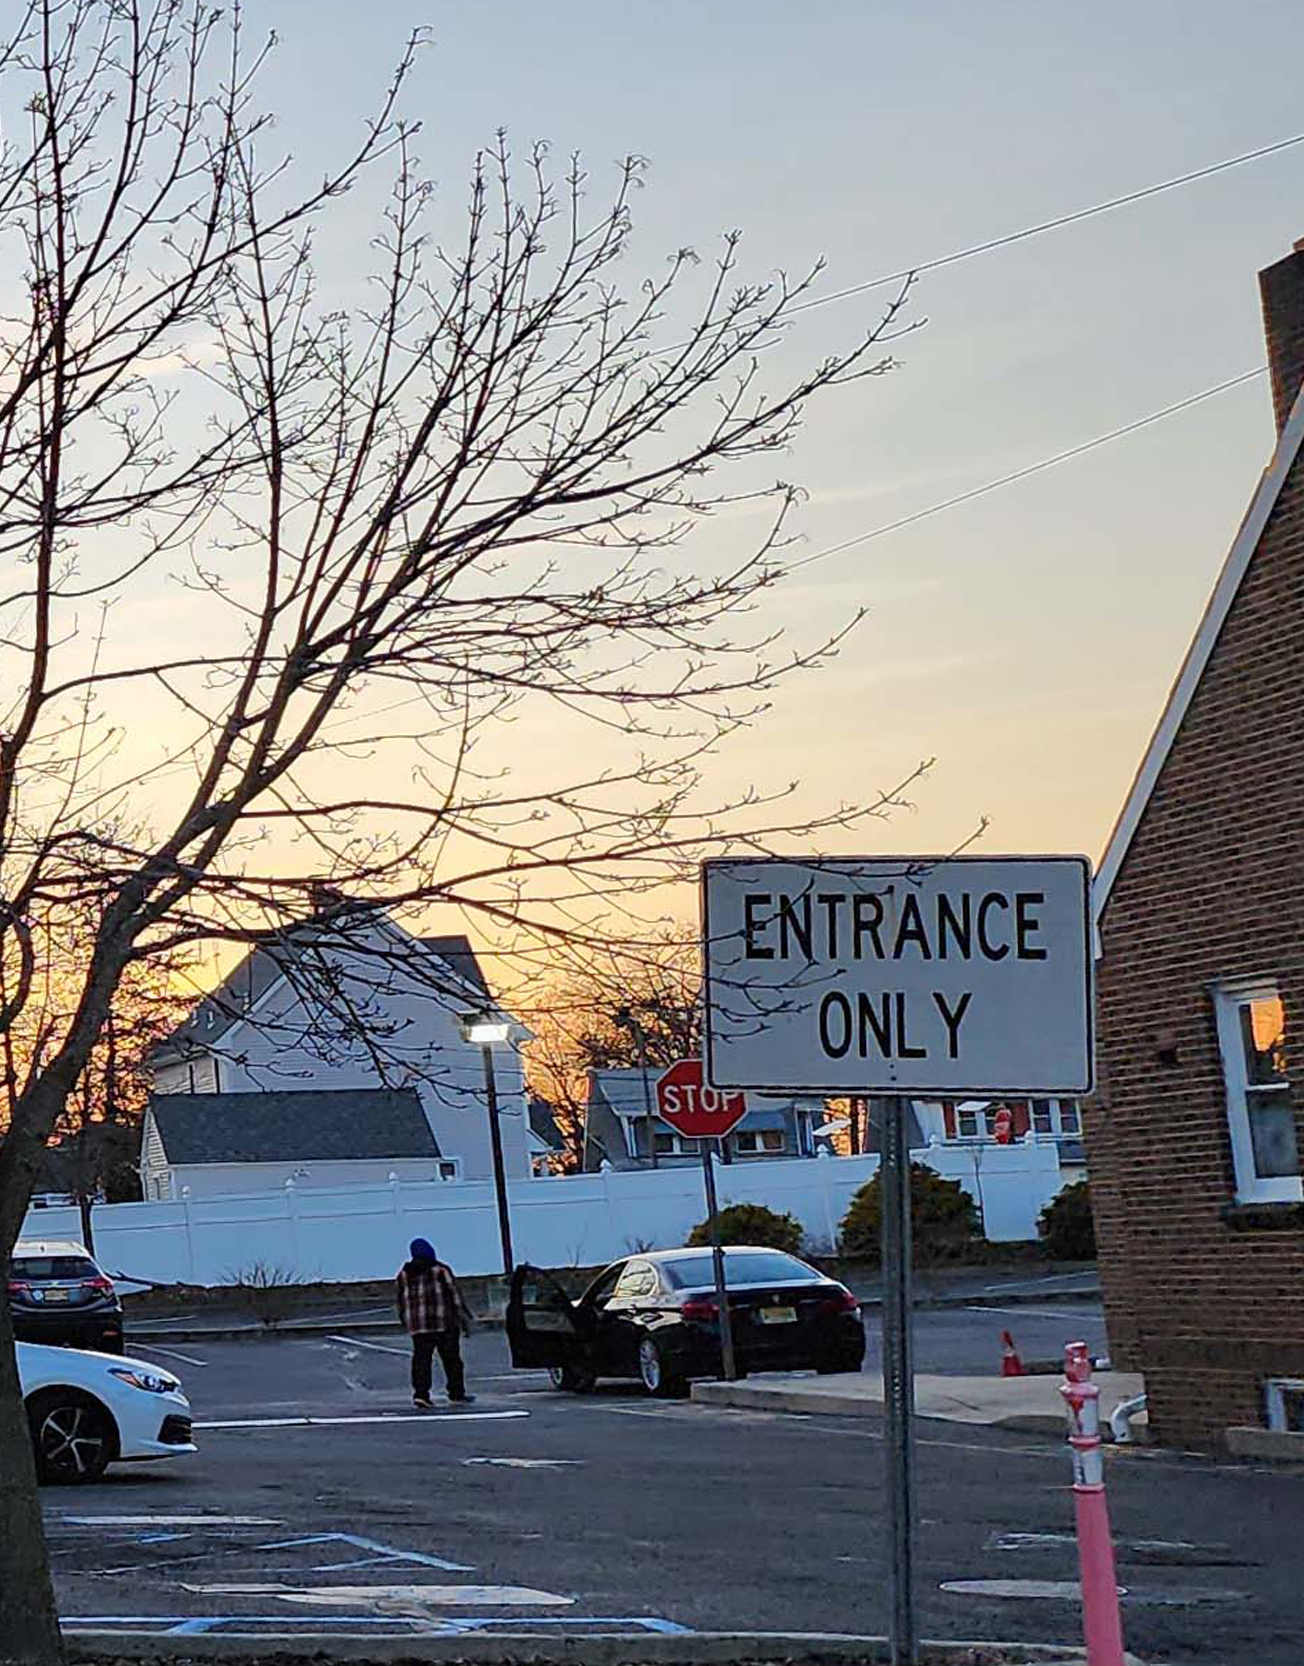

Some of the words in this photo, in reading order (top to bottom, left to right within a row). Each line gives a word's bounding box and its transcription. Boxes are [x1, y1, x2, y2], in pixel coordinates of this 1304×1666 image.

[743, 892, 1047, 961] ENTRANCE
[819, 991, 972, 1060] ONLY
[663, 1084, 738, 1113] STOP
